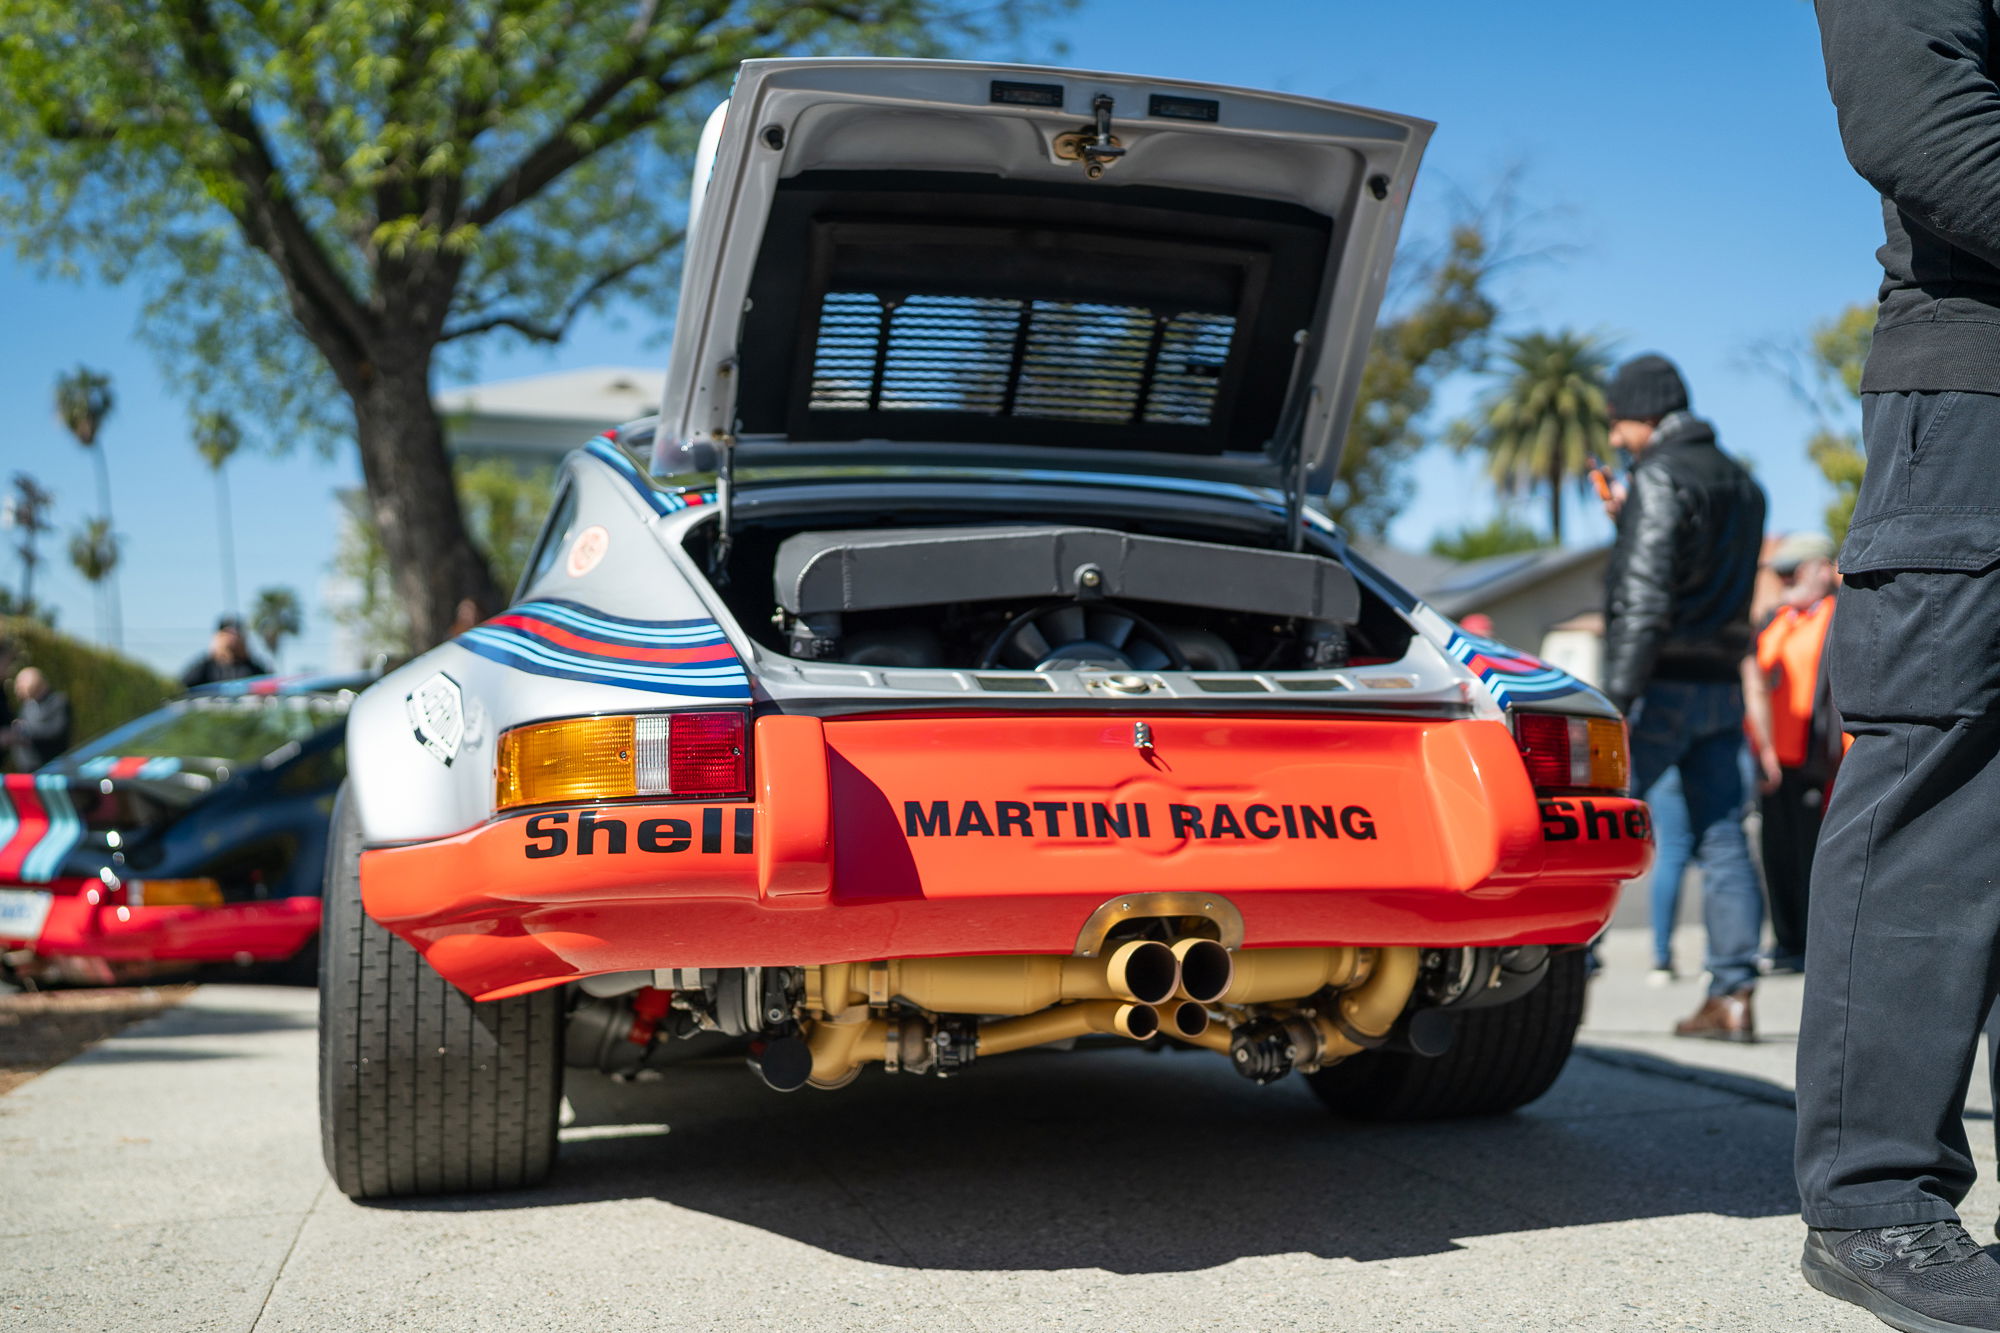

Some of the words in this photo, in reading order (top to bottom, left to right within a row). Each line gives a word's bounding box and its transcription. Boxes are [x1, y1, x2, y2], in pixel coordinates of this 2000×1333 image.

[525, 807, 754, 859] Shell
[904, 800, 1151, 838] MARTINI
[1171, 803, 1378, 841] RACING
